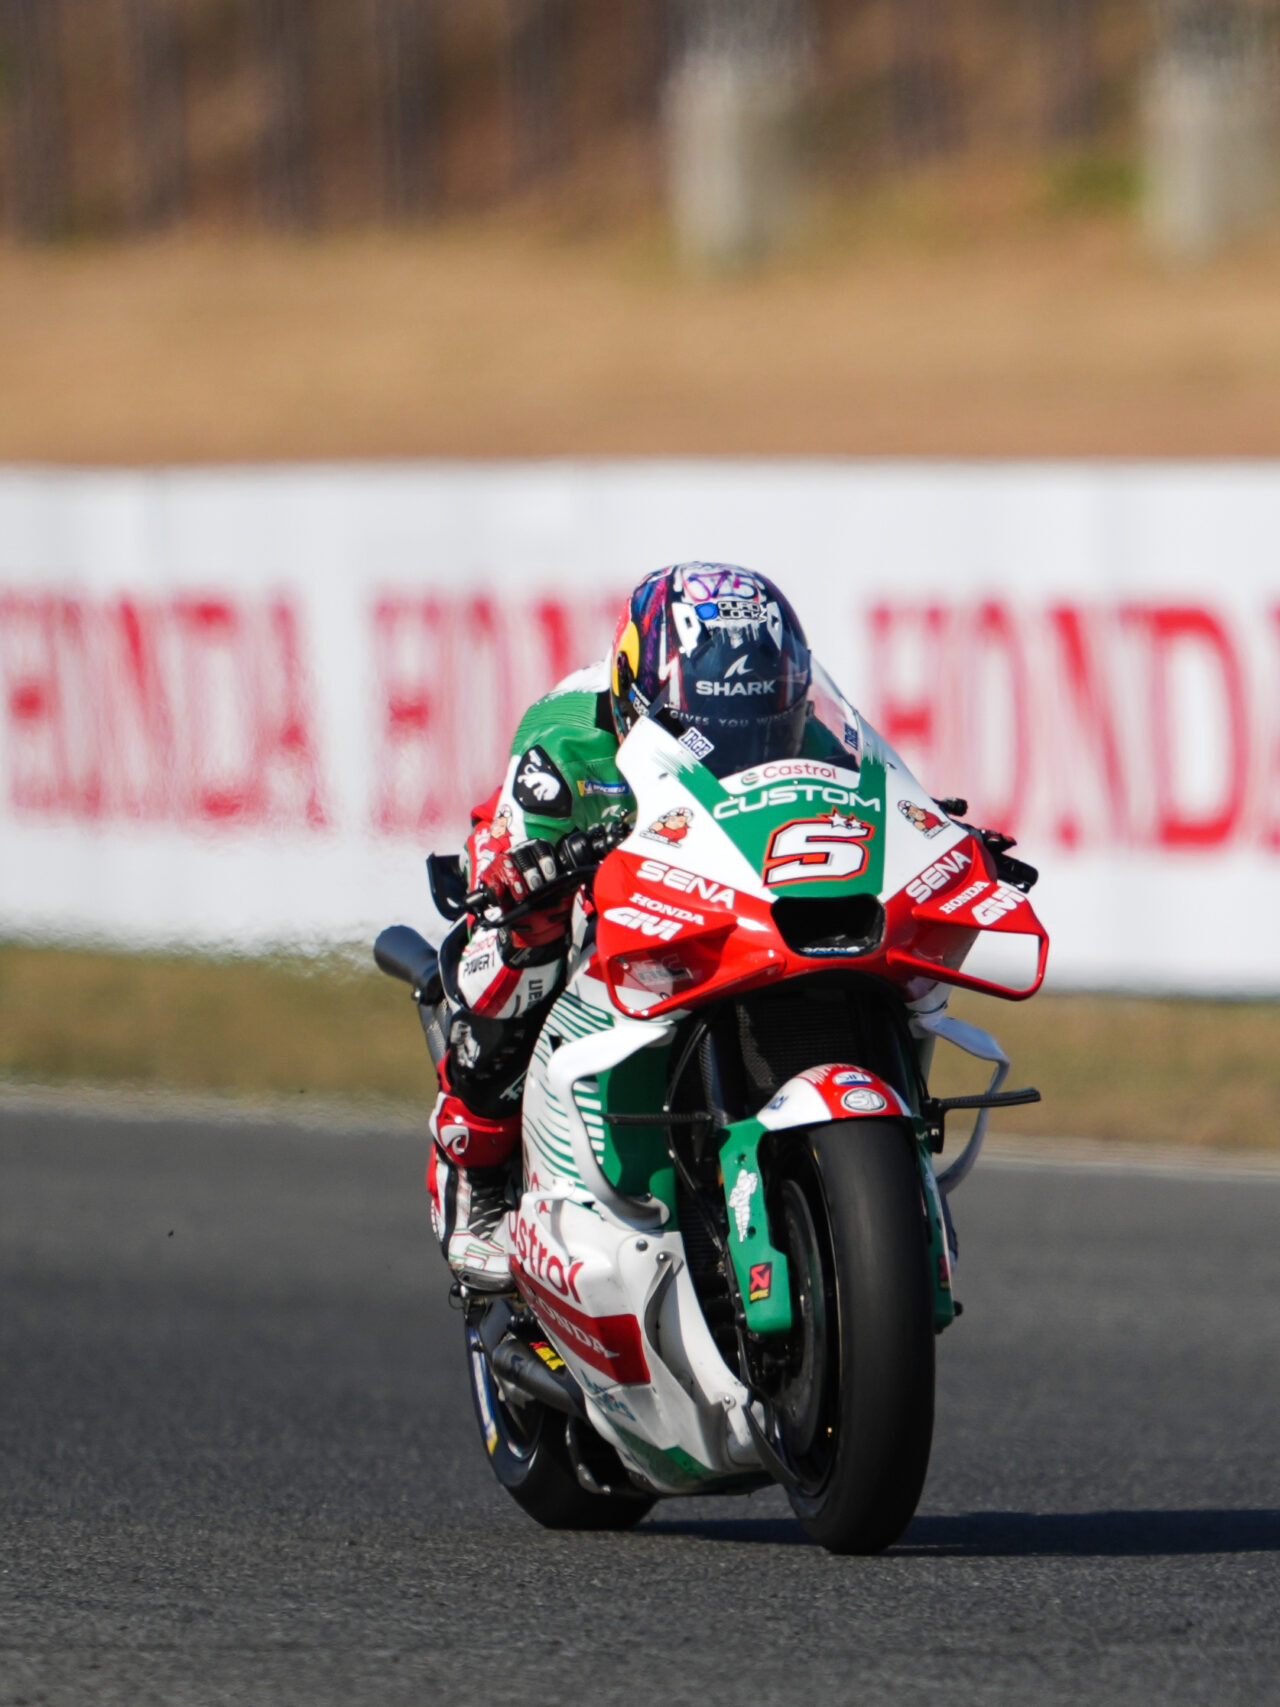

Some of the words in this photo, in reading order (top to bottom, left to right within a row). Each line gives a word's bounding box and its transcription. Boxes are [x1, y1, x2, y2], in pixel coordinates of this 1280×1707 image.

[696, 680, 776, 696] SHARK
[718, 718, 749, 728] YOU
[763, 763, 837, 779] Castrol
[713, 784, 881, 820] CUSTOM
[636, 860, 735, 910] SENA
[906, 850, 972, 904] SENA
[629, 892, 705, 926] HONDA
[939, 881, 991, 914] HONDA
[603, 906, 683, 941] GIVI
[508, 1211, 584, 1304] astrol
